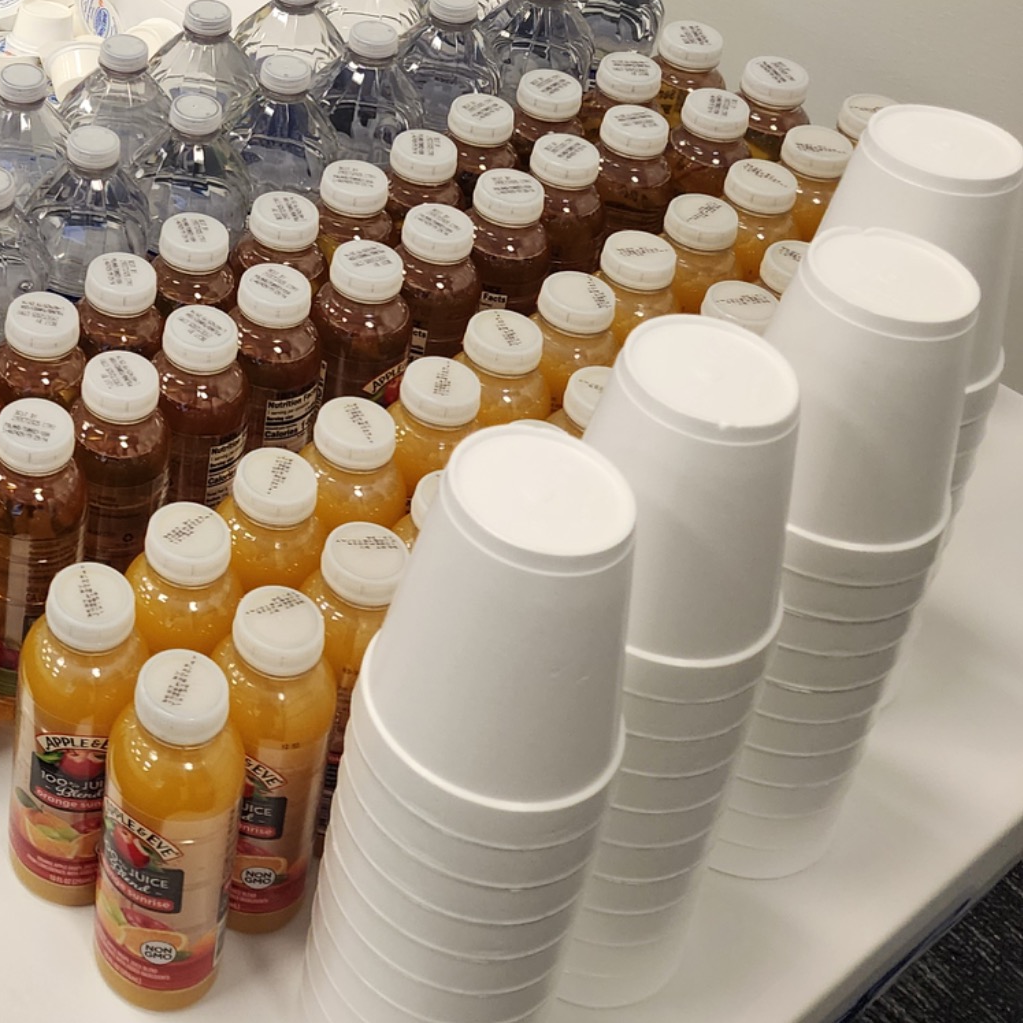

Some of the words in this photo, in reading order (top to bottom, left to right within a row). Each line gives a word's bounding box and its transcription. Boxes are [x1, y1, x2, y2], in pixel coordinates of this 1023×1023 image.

[483, 292, 506, 303] Facts
[372, 364, 402, 393] APPLE
[267, 397, 302, 409] Nutrition
[264, 428, 298, 438] Calories
[46, 736, 90, 750] APPLE
[40, 770, 79, 789] 100%
[251, 764, 278, 787] EVE
[36, 789, 79, 808] orange
[242, 804, 273, 817] UICE
[240, 824, 273, 835] nrise
[146, 833, 174, 858] EVE
[129, 868, 169, 889] JUICE
[245, 870, 273, 878] NON
[244, 877, 272, 885] GMO
[126, 888, 171, 910] sunrise
[145, 944, 173, 954] NON
[144, 952, 172, 961] GMO
